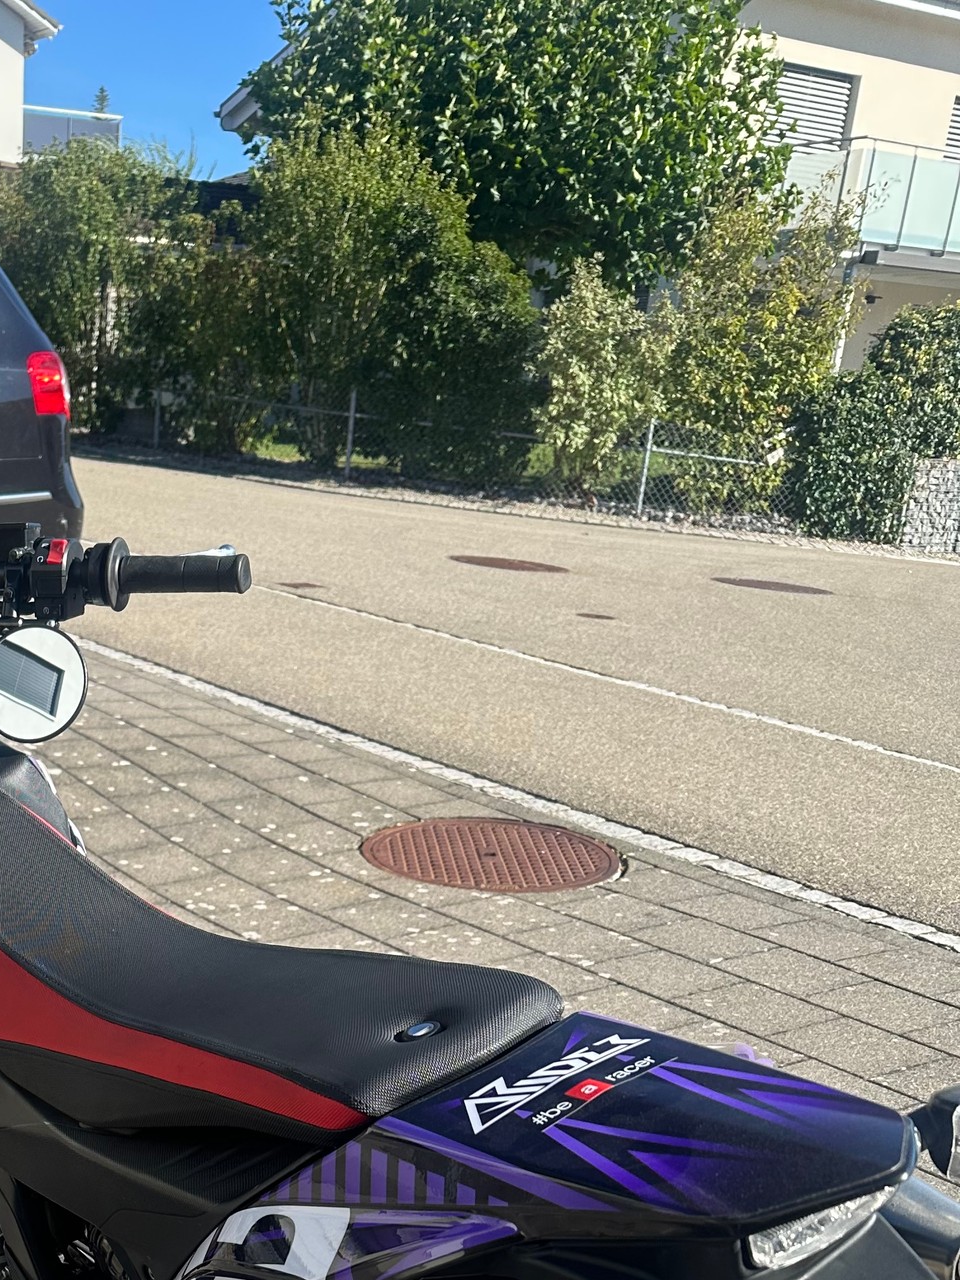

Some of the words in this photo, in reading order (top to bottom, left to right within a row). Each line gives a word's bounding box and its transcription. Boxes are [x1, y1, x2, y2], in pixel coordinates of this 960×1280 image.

[532, 1102, 572, 1125] #be
[581, 1085, 598, 1095] a
[605, 1056, 656, 1082] racer
